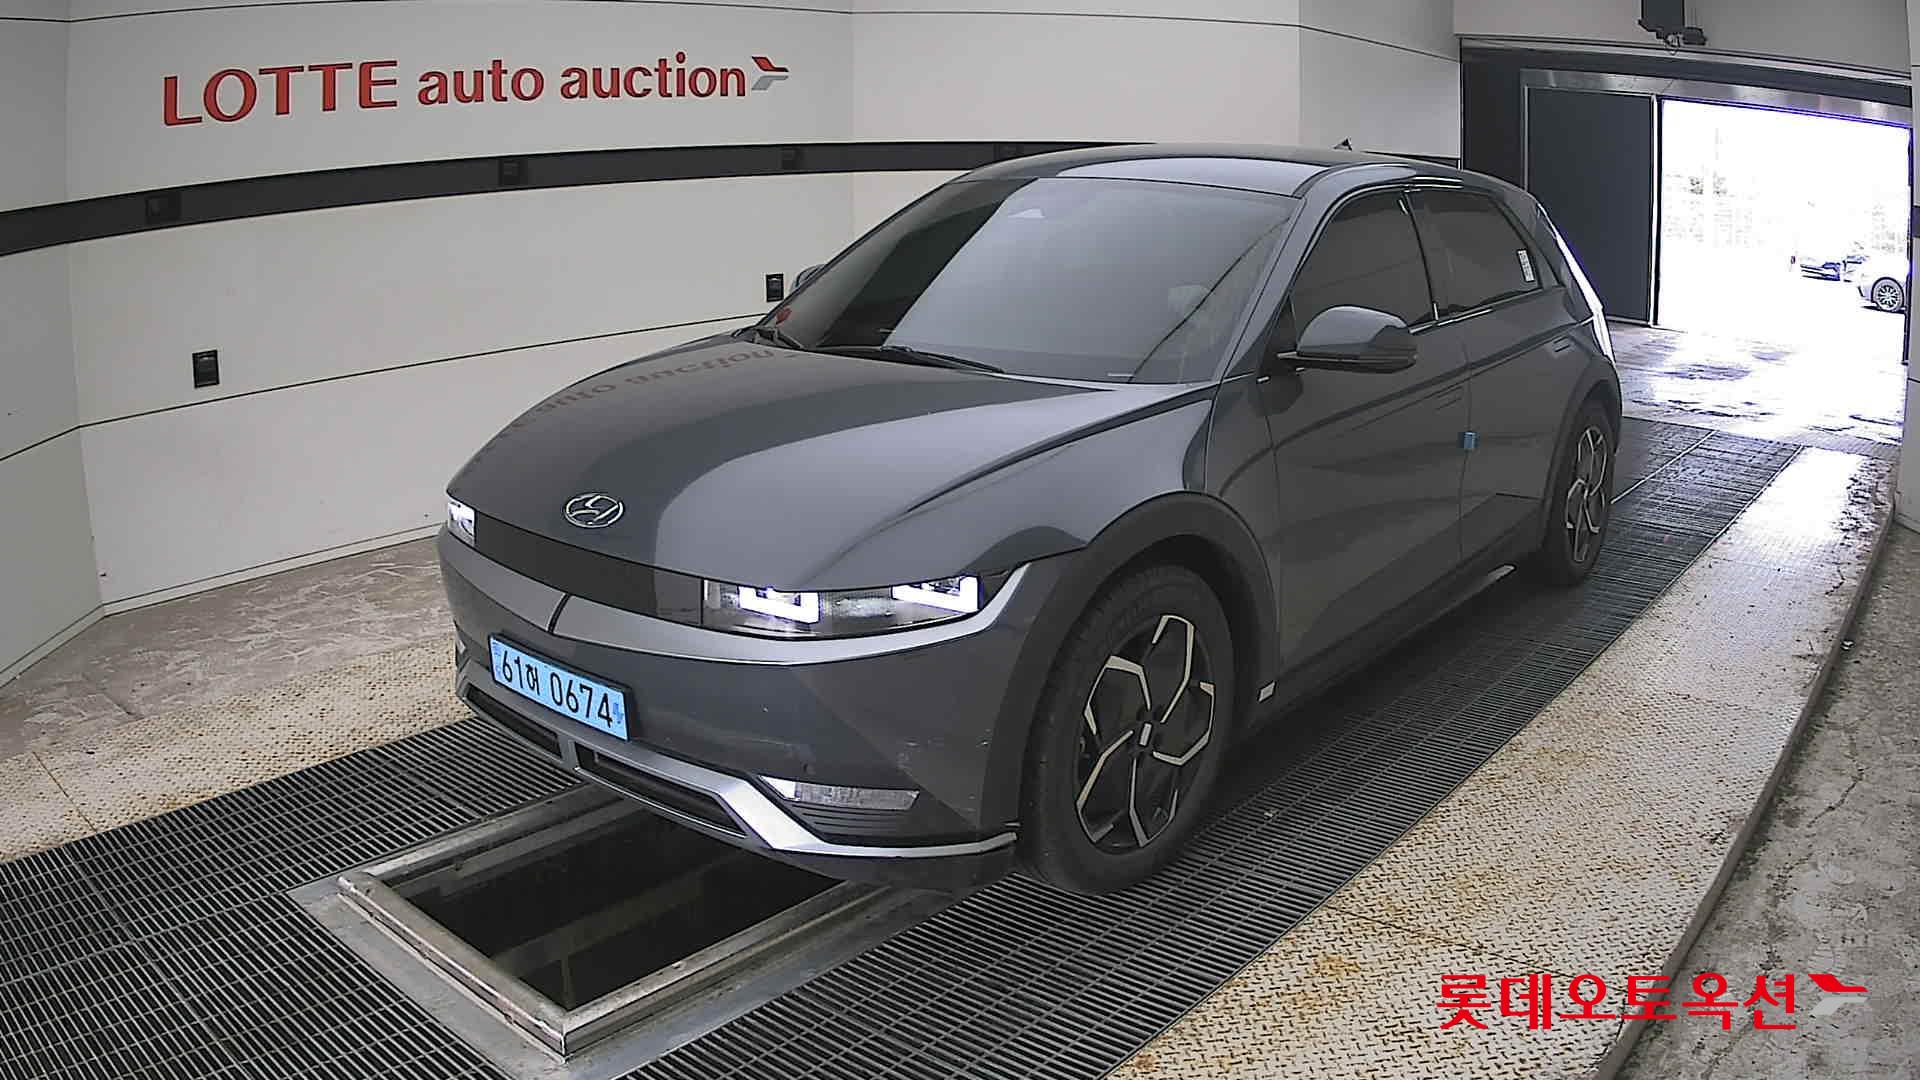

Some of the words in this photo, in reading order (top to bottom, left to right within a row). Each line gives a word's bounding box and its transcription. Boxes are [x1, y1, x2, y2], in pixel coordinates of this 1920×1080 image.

[163, 60, 398, 126] LOTTE
[417, 59, 545, 105] auto
[560, 51, 746, 99] auction
[502, 650, 541, 696] 61허
[550, 671, 613, 728] 0674
